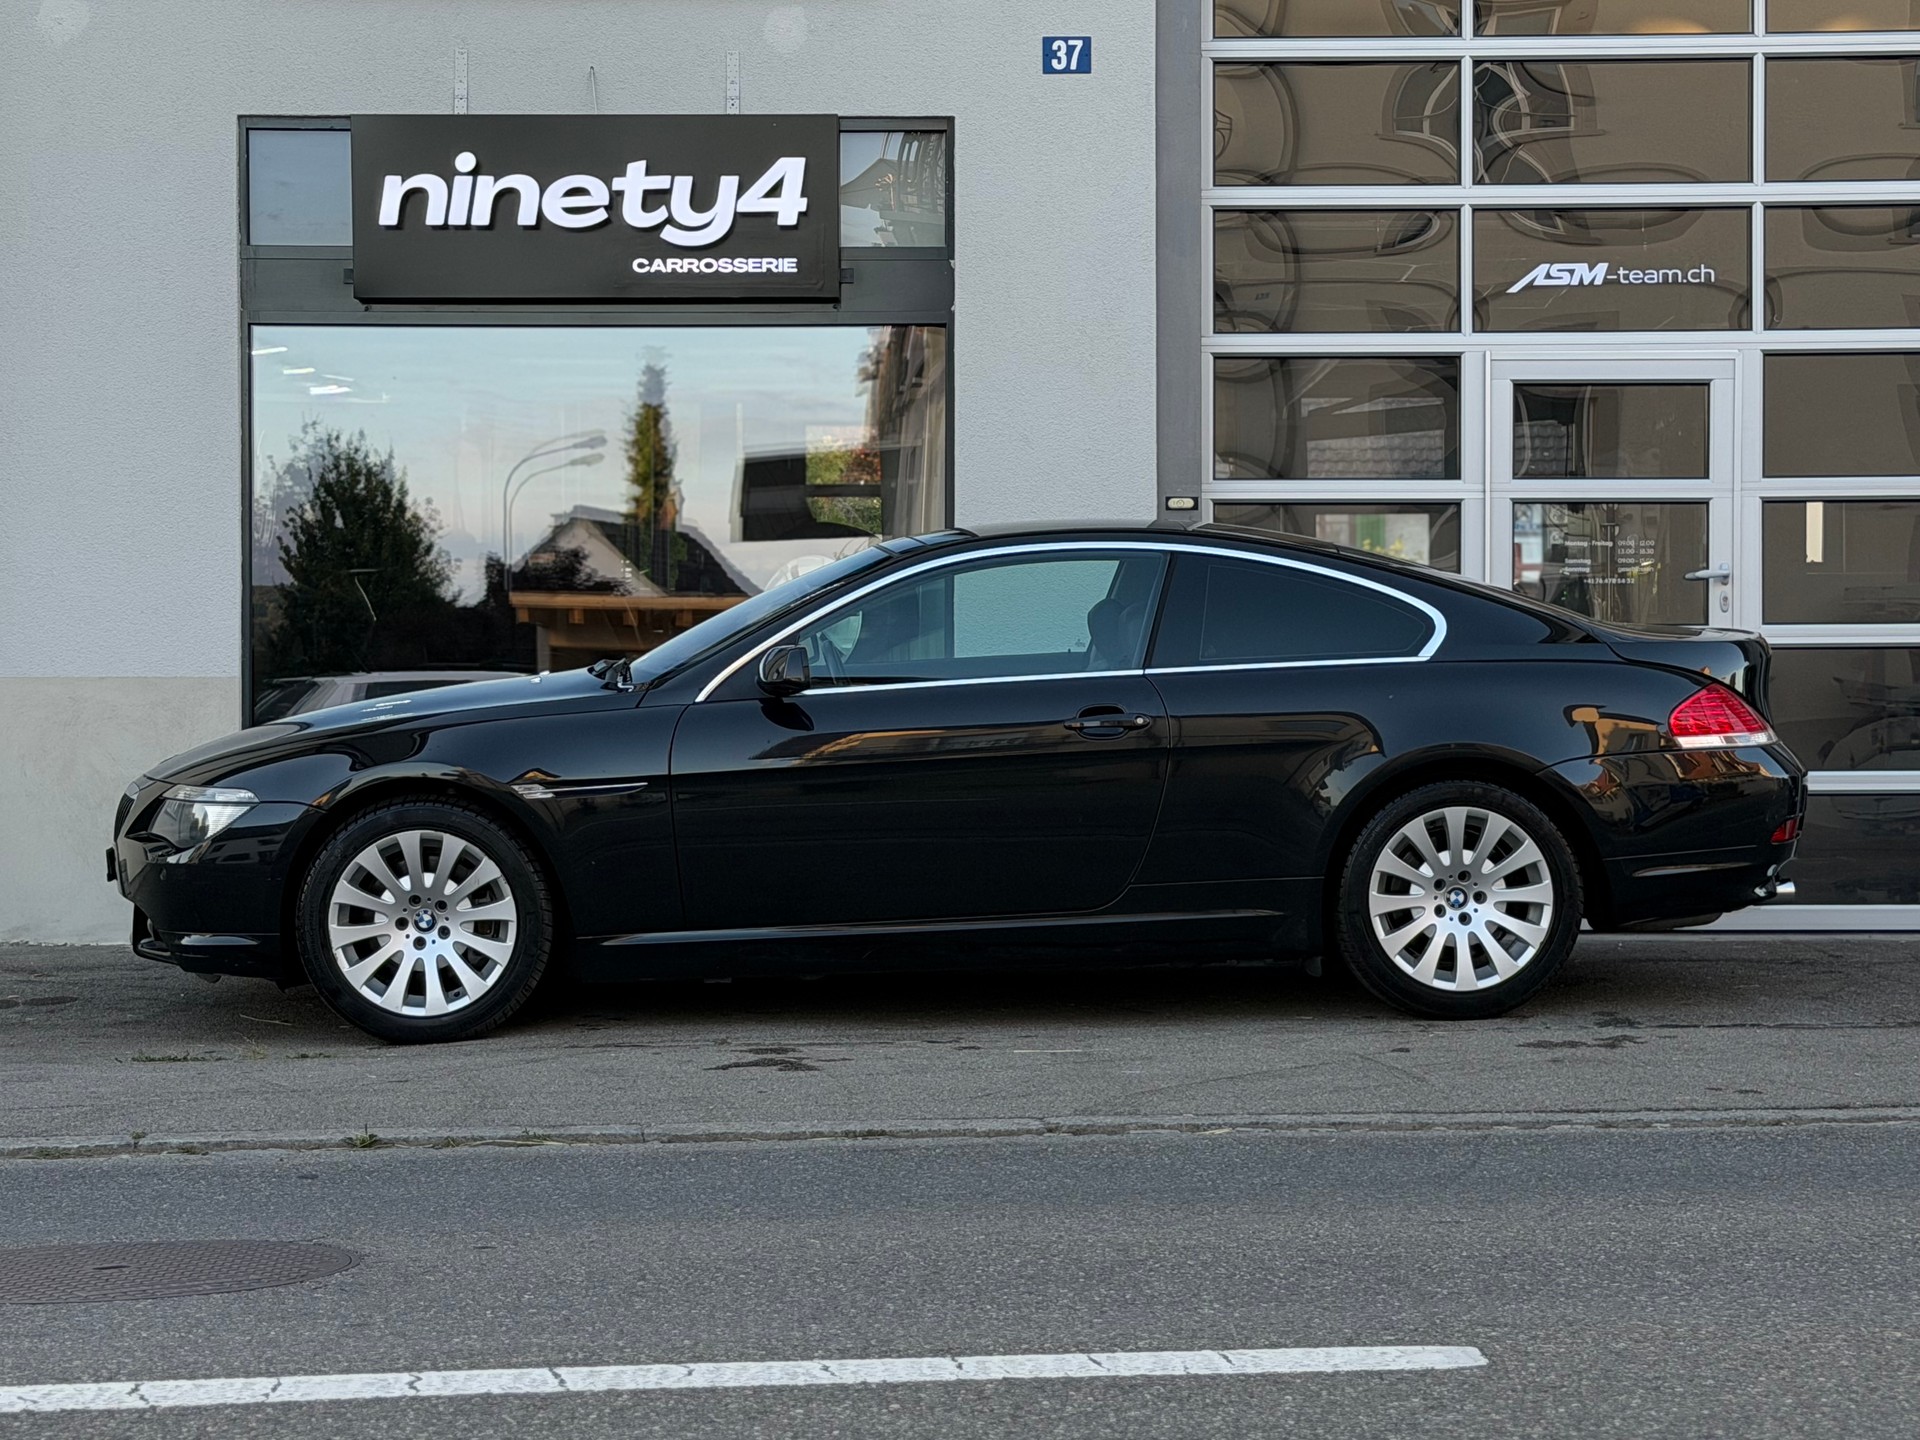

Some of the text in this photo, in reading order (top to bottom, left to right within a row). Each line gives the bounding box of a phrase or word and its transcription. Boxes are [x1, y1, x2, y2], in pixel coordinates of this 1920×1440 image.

[1051, 39, 1083, 70] 37
[378, 151, 808, 247] ninety4
[632, 257, 798, 273] CARROSSERIE
[1592, 539, 1613, 547] Freitag
